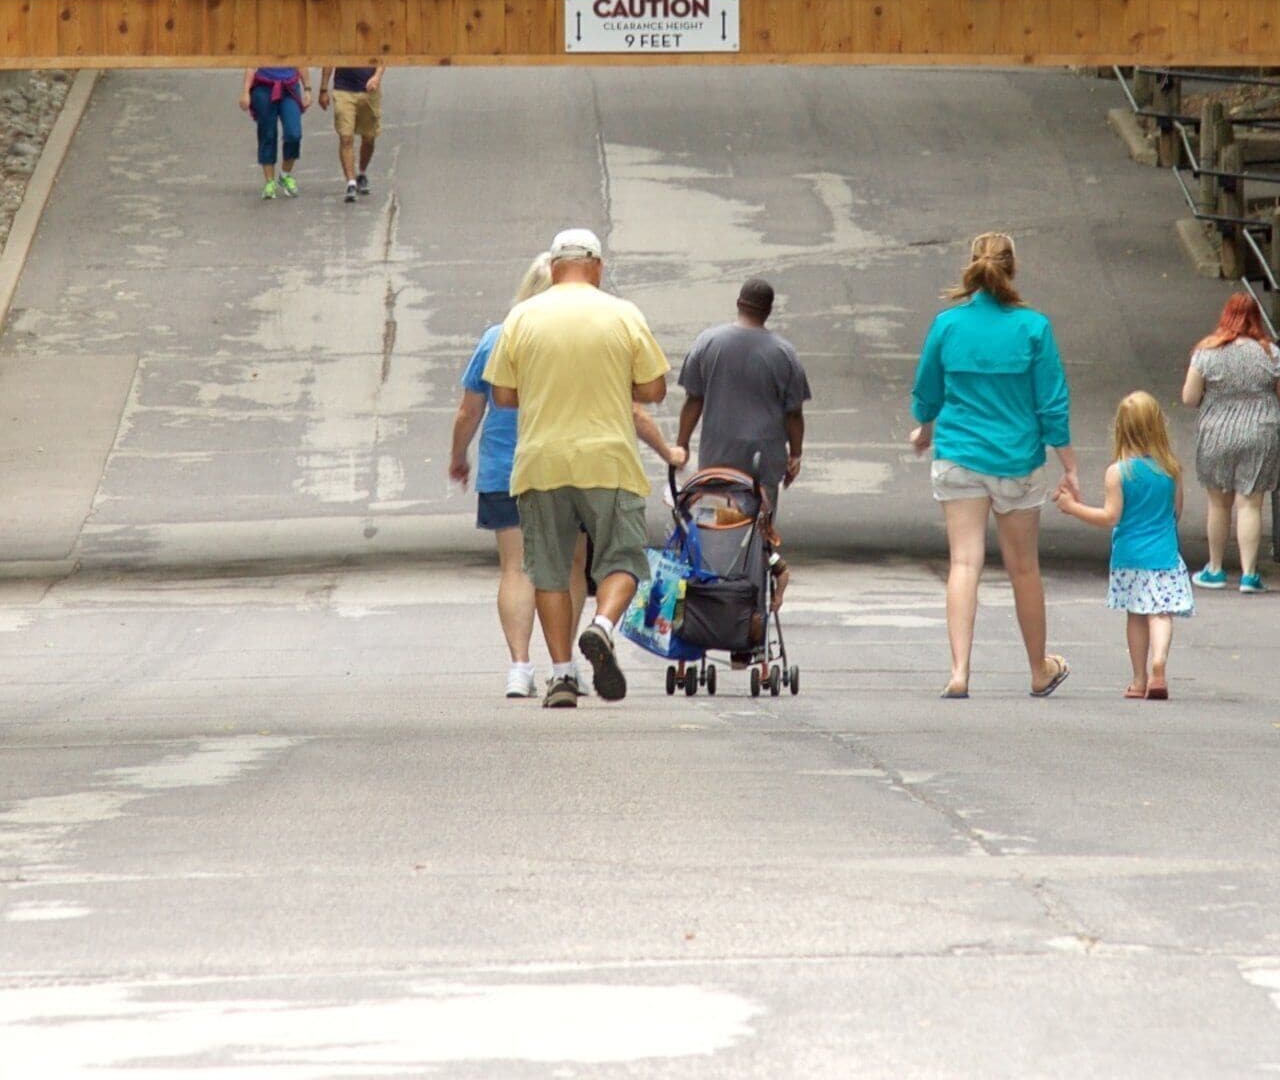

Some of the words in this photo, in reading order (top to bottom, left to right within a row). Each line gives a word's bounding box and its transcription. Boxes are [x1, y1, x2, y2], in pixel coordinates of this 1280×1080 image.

[603, 22, 664, 31] CLEARANCE
[666, 22, 703, 31] HEIGHT
[625, 34, 635, 47] 9
[641, 34, 683, 47] FEET
